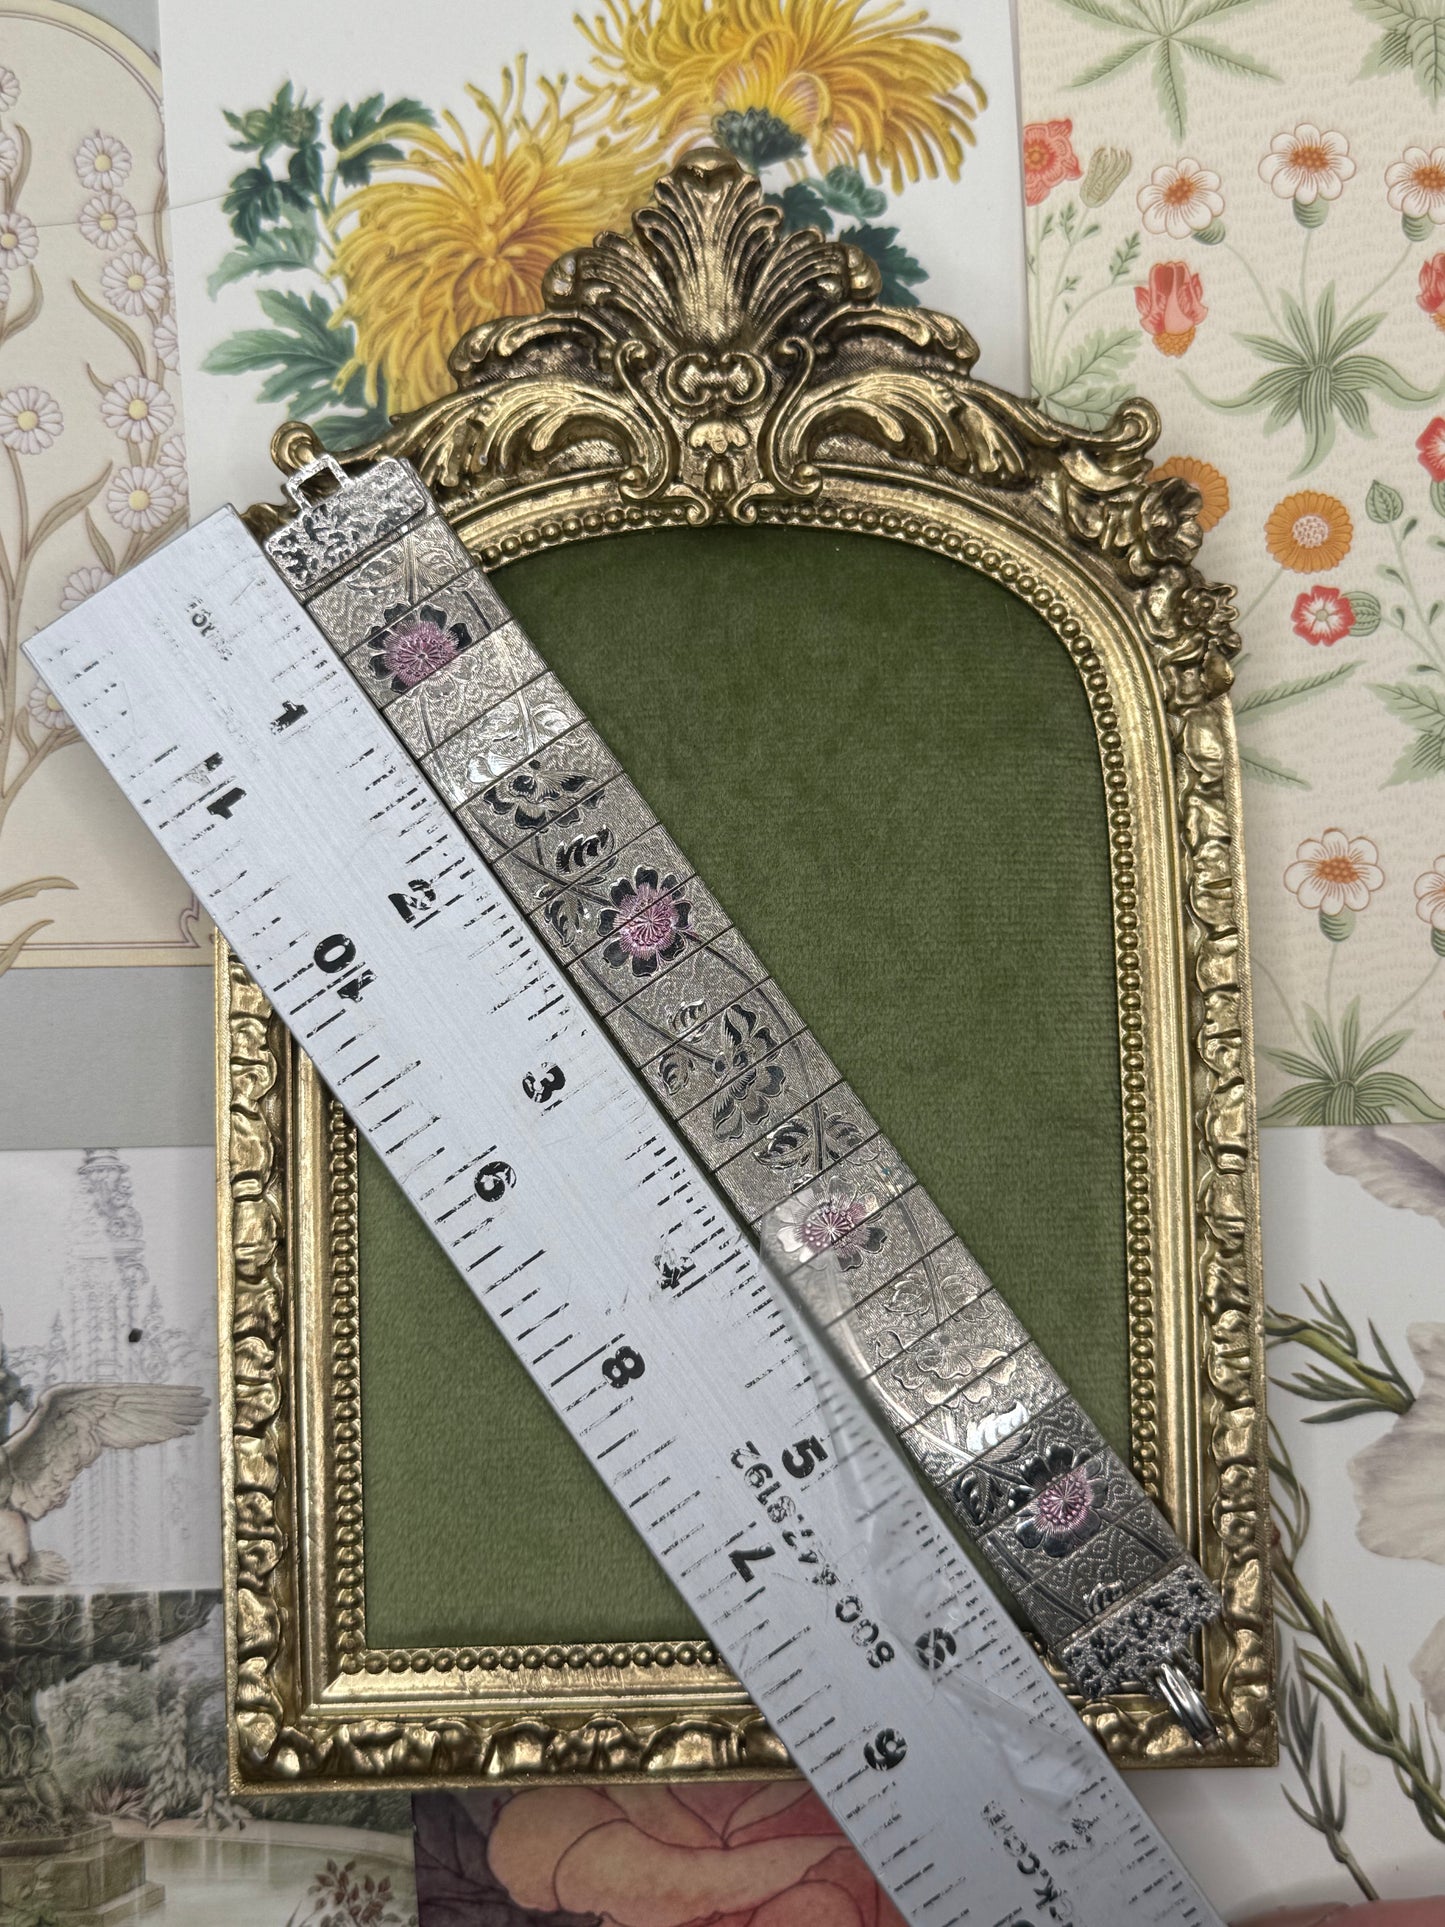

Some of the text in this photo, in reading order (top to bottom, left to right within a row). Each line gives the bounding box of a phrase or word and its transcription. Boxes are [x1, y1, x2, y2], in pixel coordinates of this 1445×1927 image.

[387, 878, 438, 924] 2
[521, 1061, 567, 1103] 3
[473, 1161, 517, 1203] 9
[601, 1345, 646, 1389] 8
[781, 1437, 829, 1480] 5
[727, 1541, 776, 1583] 7
[913, 1626, 958, 1671] 6
